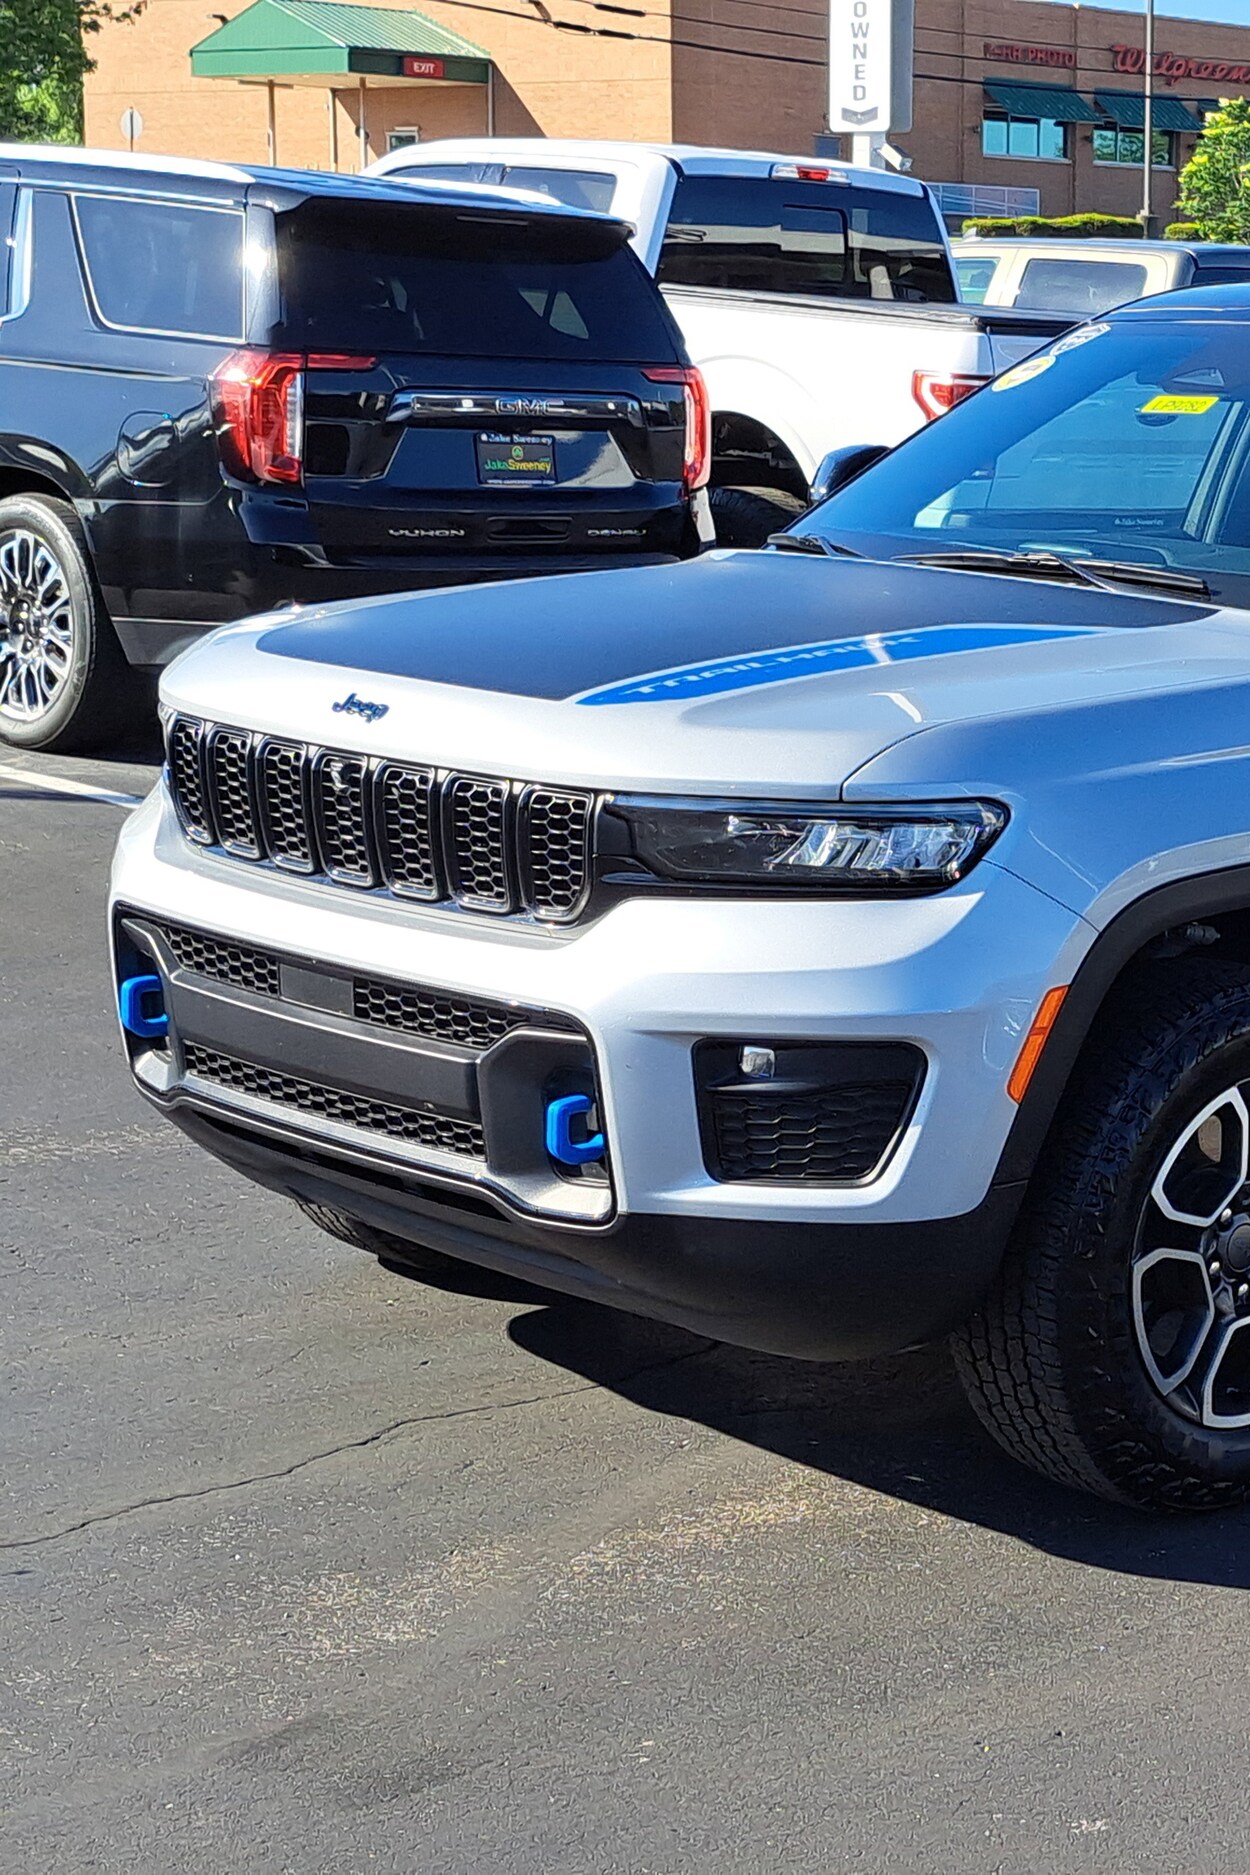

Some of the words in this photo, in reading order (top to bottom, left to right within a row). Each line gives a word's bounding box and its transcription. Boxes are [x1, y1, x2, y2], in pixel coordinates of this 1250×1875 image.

[850, 1, 870, 101] OWNED
[1028, 49, 1075, 67] PHOTO
[413, 61, 435, 74] EXIT
[495, 398, 565, 417] GMC
[388, 528, 466, 538] YUKON
[587, 528, 647, 538] DENALI
[331, 692, 390, 724] Jeep
